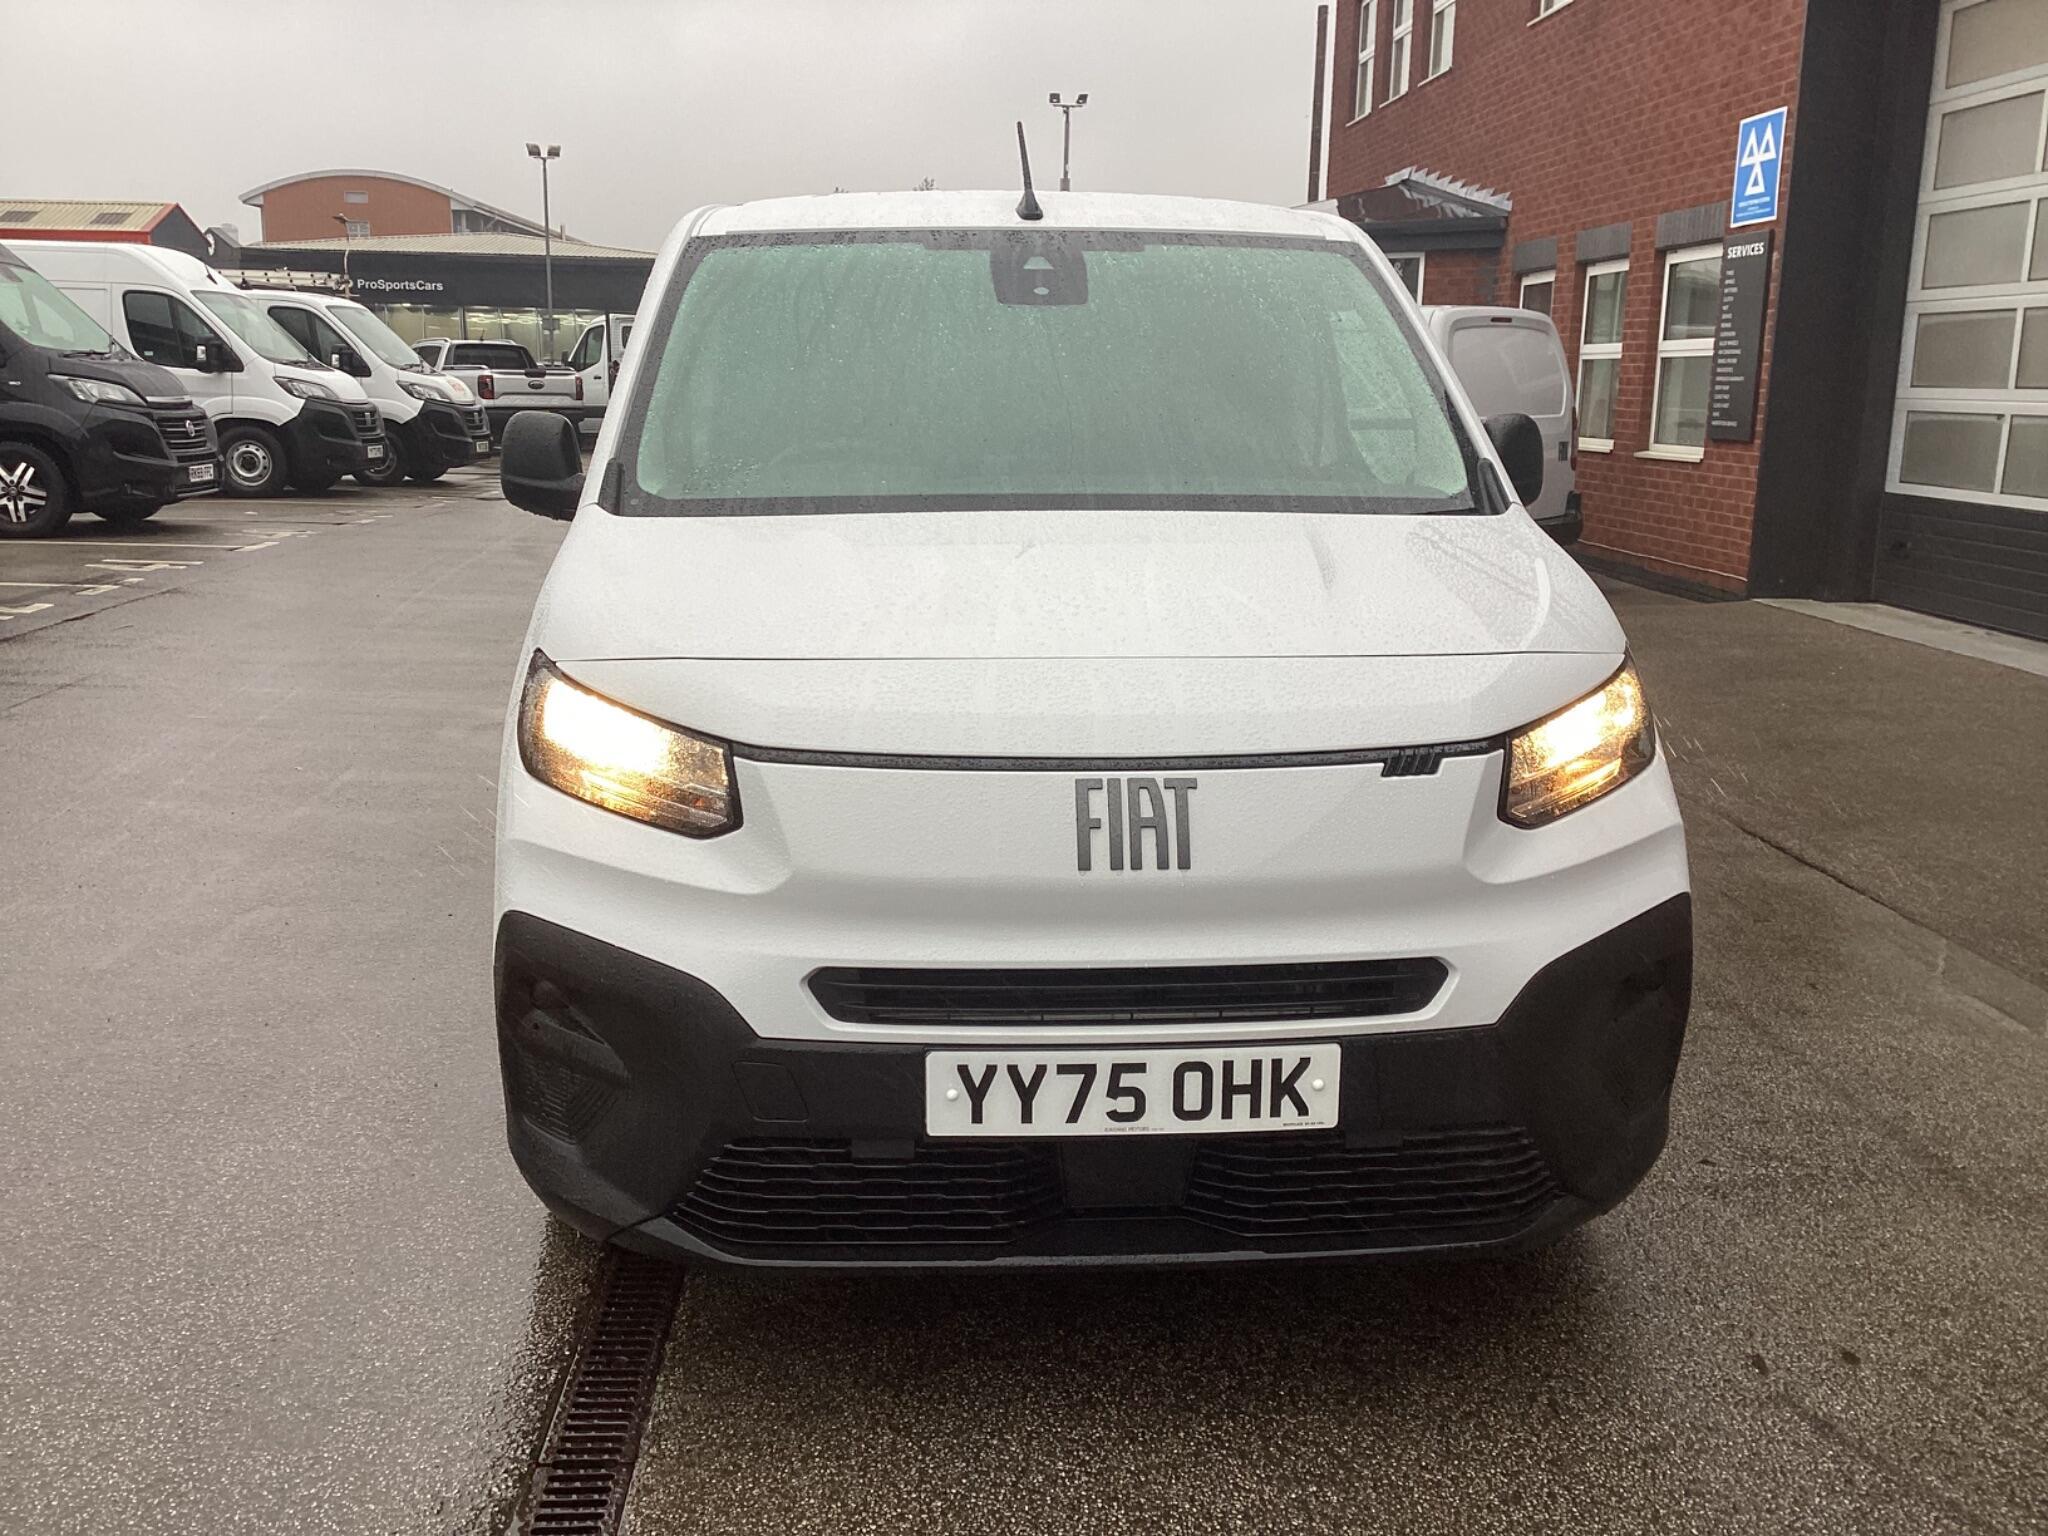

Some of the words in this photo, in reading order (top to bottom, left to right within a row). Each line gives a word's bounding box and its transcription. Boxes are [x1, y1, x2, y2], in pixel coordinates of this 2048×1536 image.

[1728, 242, 1765, 259] SERVICES
[357, 279, 444, 291] ProSportsCars
[1075, 777, 1198, 871] FIAT
[956, 1062, 1147, 1124] YY75
[1172, 1057, 1311, 1121] OHK
